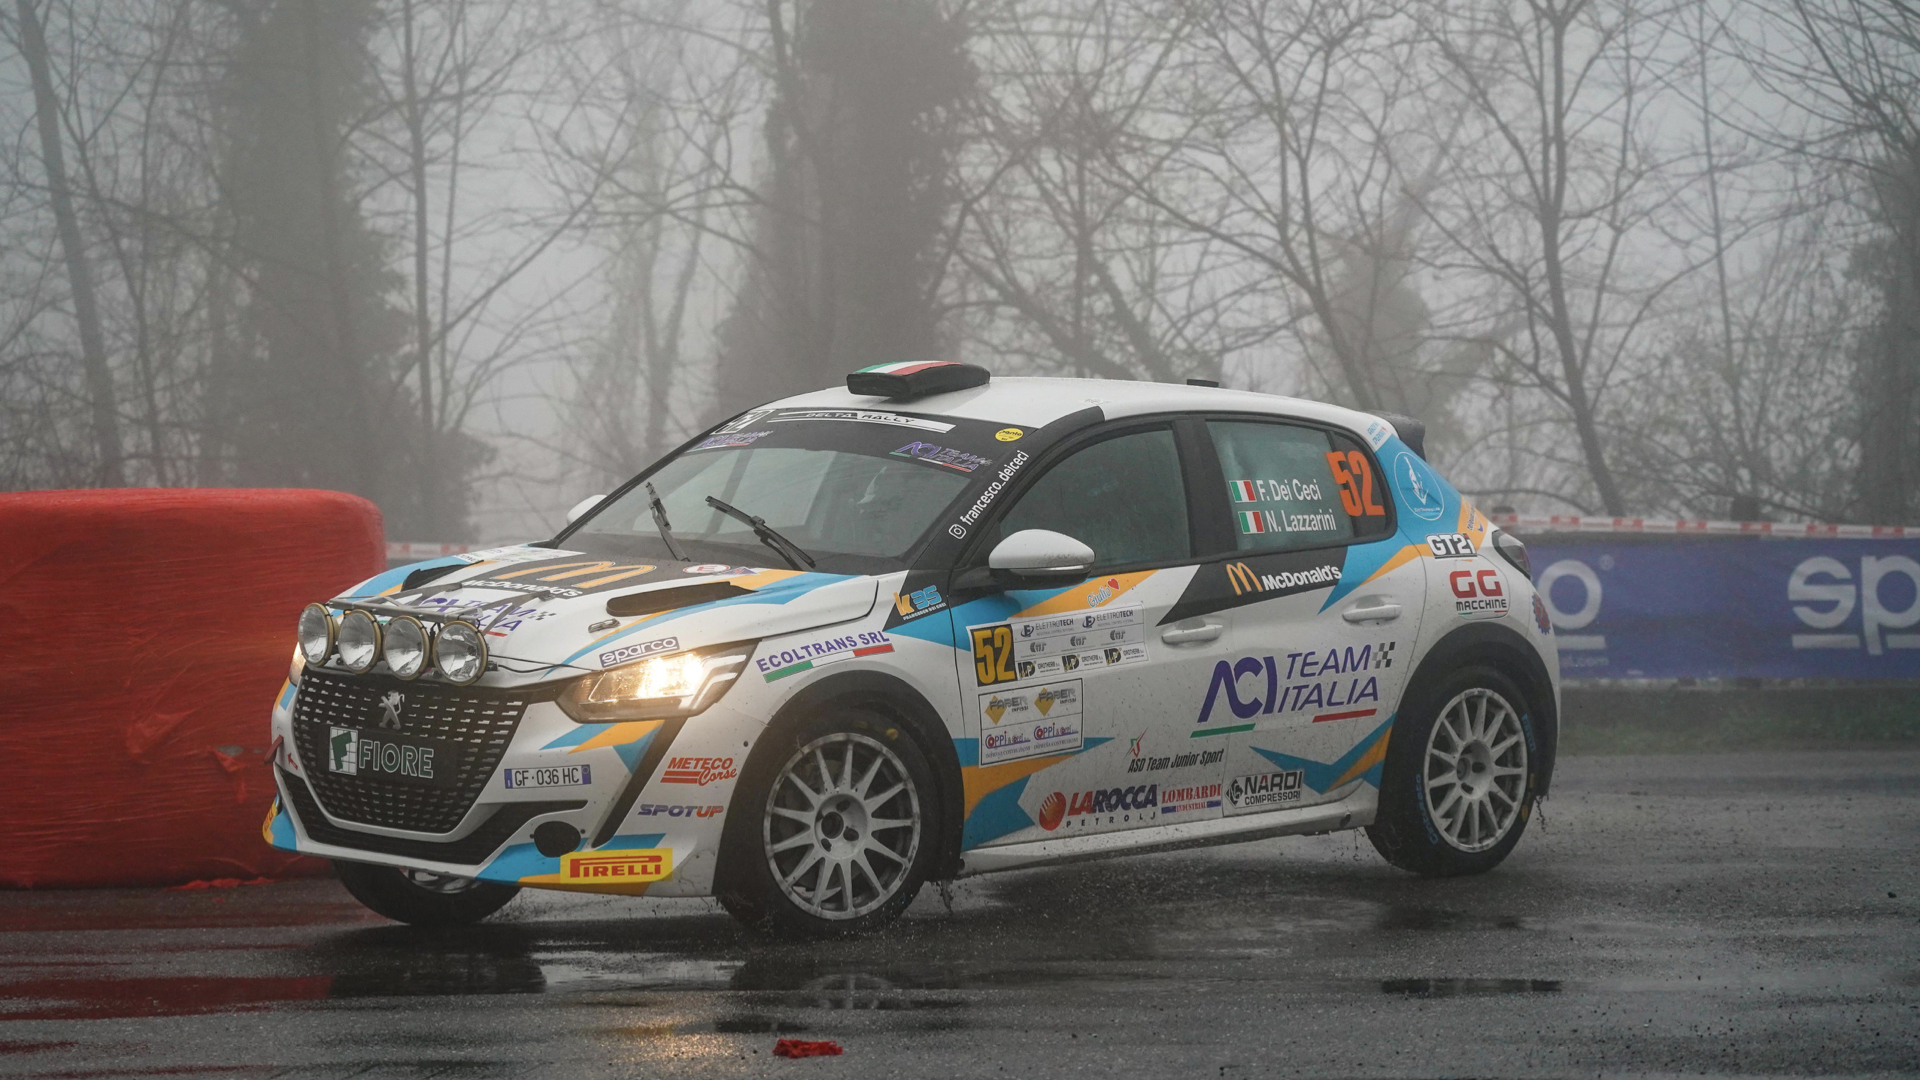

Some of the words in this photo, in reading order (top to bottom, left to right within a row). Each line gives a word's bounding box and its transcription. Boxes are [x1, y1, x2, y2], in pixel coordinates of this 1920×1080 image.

[861, 414, 915, 423] RALLY
[959, 449, 1029, 526] francesco_deiceci
[1256, 479, 1270, 501] F.
[1269, 479, 1292, 501] Dei
[1292, 478, 1322, 500] Ceci
[1325, 450, 1385, 517] 52
[1265, 510, 1282, 532] N.
[1281, 508, 1337, 532] Lazzarini
[1261, 565, 1342, 591] McDonald's
[1449, 569, 1503, 598] GG
[1096, 609, 1134, 622] ELETTROTECH
[1456, 599, 1507, 611] MACCHINE
[602, 637, 676, 664] sparco
[755, 635, 858, 673] ECOLTRANS
[858, 630, 890, 645] SRL
[973, 626, 1016, 685] 52
[1038, 688, 1077, 703] FABER
[1196, 655, 1278, 724] ACI
[1286, 644, 1372, 679] TEAM
[1277, 676, 1379, 713] ITALIA
[989, 695, 1028, 711] FABER
[358, 738, 434, 779] FIORE
[667, 757, 734, 770] METECO
[1127, 758, 1146, 773] ASD
[1147, 756, 1170, 771] Team
[1170, 751, 1200, 768] Junior
[1200, 748, 1224, 766] Sport
[698, 767, 737, 787] Corse
[1244, 771, 1303, 795] NARDI
[1161, 783, 1221, 804] LOMBARDI
[1244, 790, 1301, 806] COMPRESSORI
[637, 803, 724, 818] SPOTUP
[1176, 801, 1206, 812] INDUSTRIAL
[569, 855, 663, 878] PIRELLI
